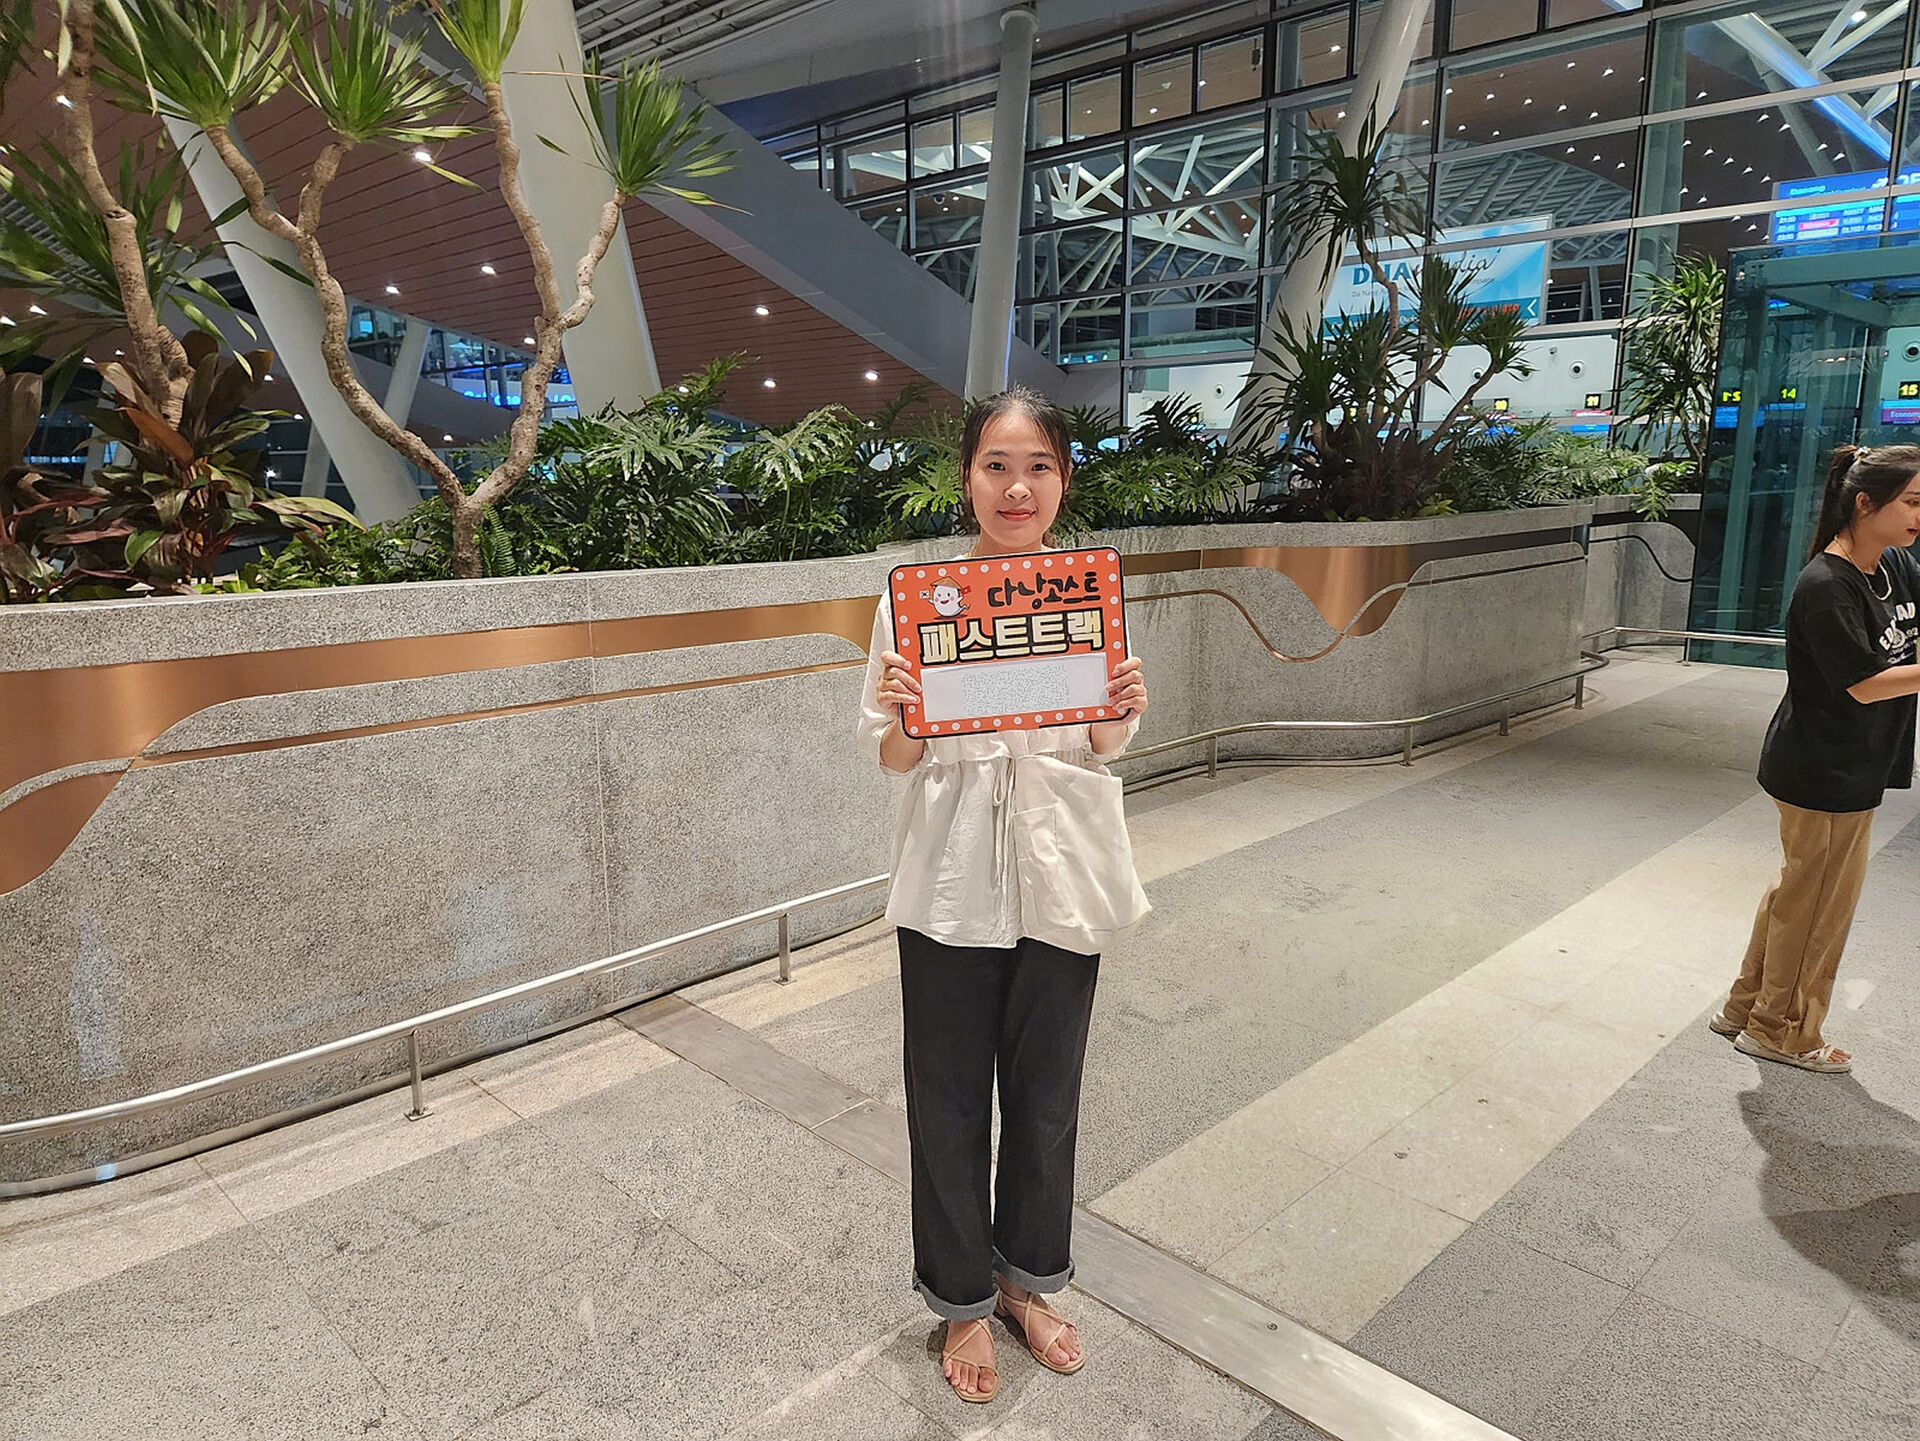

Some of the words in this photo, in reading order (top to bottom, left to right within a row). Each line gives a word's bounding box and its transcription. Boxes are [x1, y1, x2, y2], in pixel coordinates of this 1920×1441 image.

[1781, 387, 1796, 399] 14
[1900, 384, 1918, 396] 15
[987, 571, 1102, 610] 다낭고스트
[918, 608, 1104, 665] 패스트트랙
